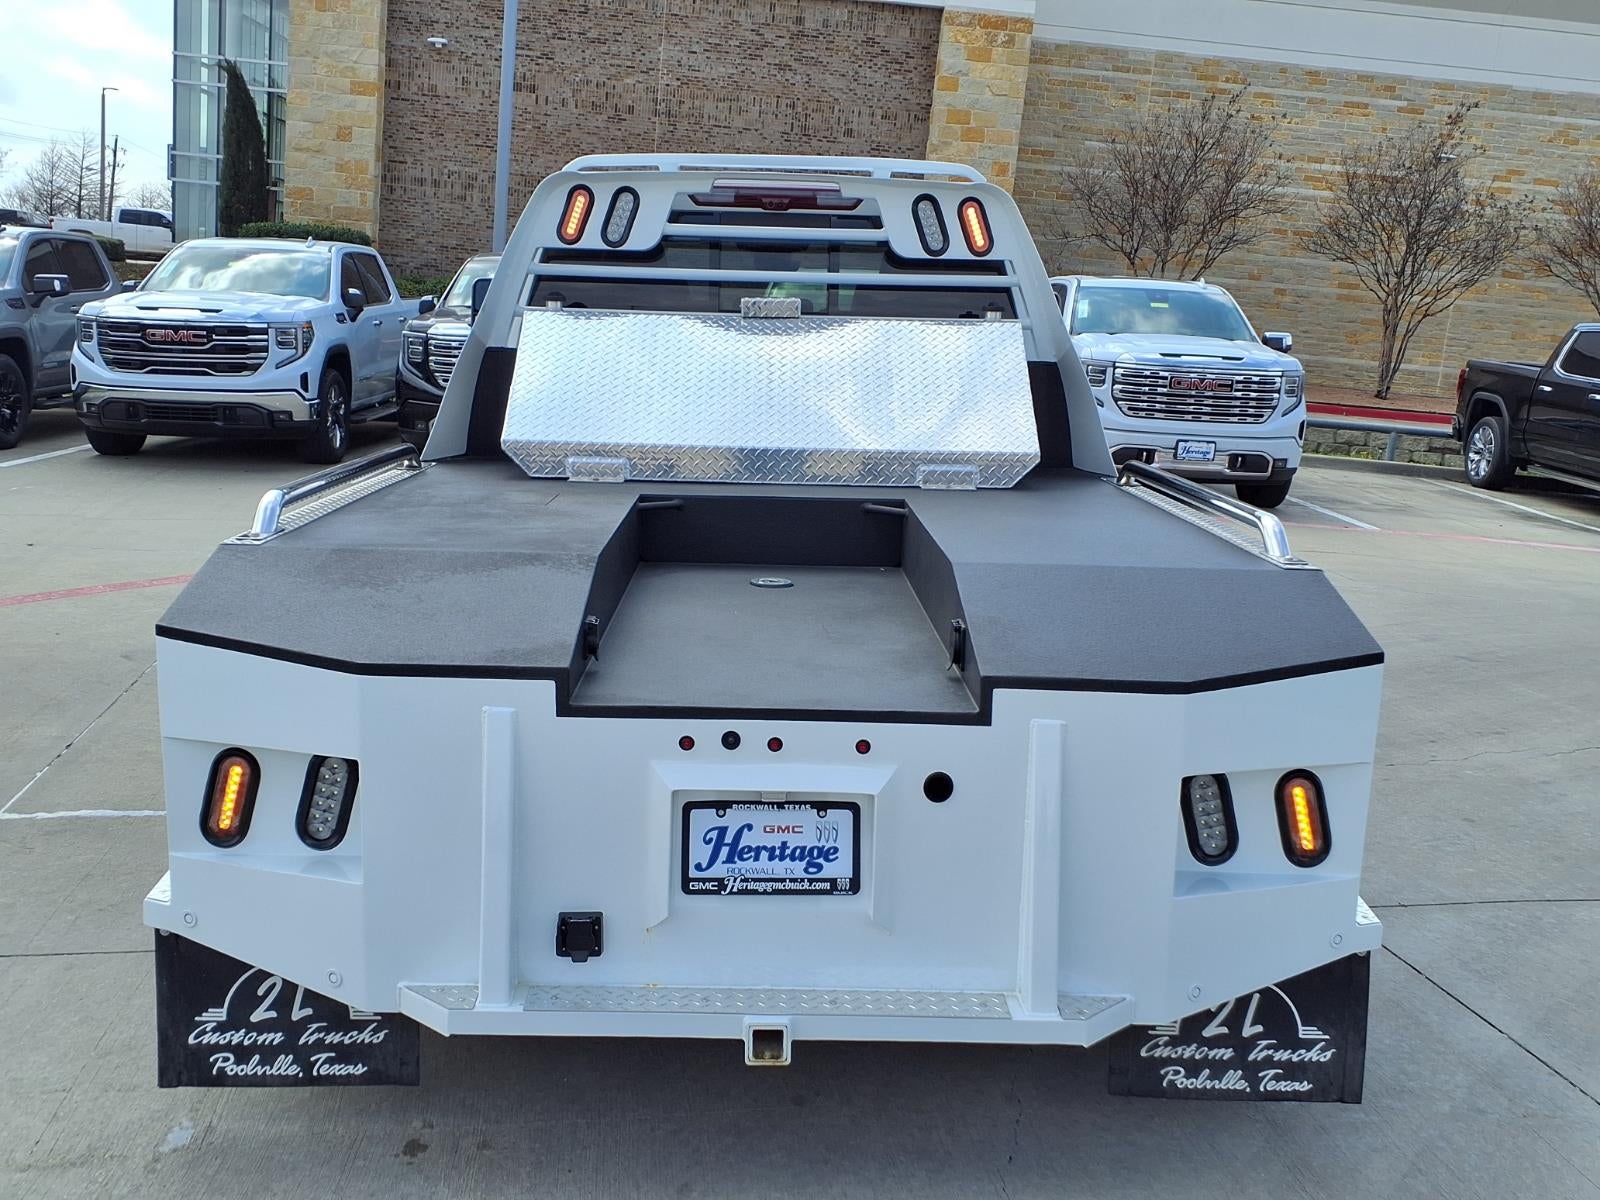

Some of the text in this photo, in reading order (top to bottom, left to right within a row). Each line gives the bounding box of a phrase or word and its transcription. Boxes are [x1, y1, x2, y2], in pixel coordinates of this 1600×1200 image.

[146, 329, 207, 342] GMC
[1172, 378, 1232, 391] GMC
[784, 804, 812, 812] TEXAS
[763, 825, 803, 834] GMC
[694, 823, 839, 875] Heritage
[784, 867, 795, 875] TX
[689, 881, 718, 890] GMC
[188, 1022, 388, 1045] Custom Trucks
[1140, 1036, 1336, 1062] Custom Trucks
[310, 1052, 367, 1076] Texas
[1258, 1069, 1313, 1091] Texas
